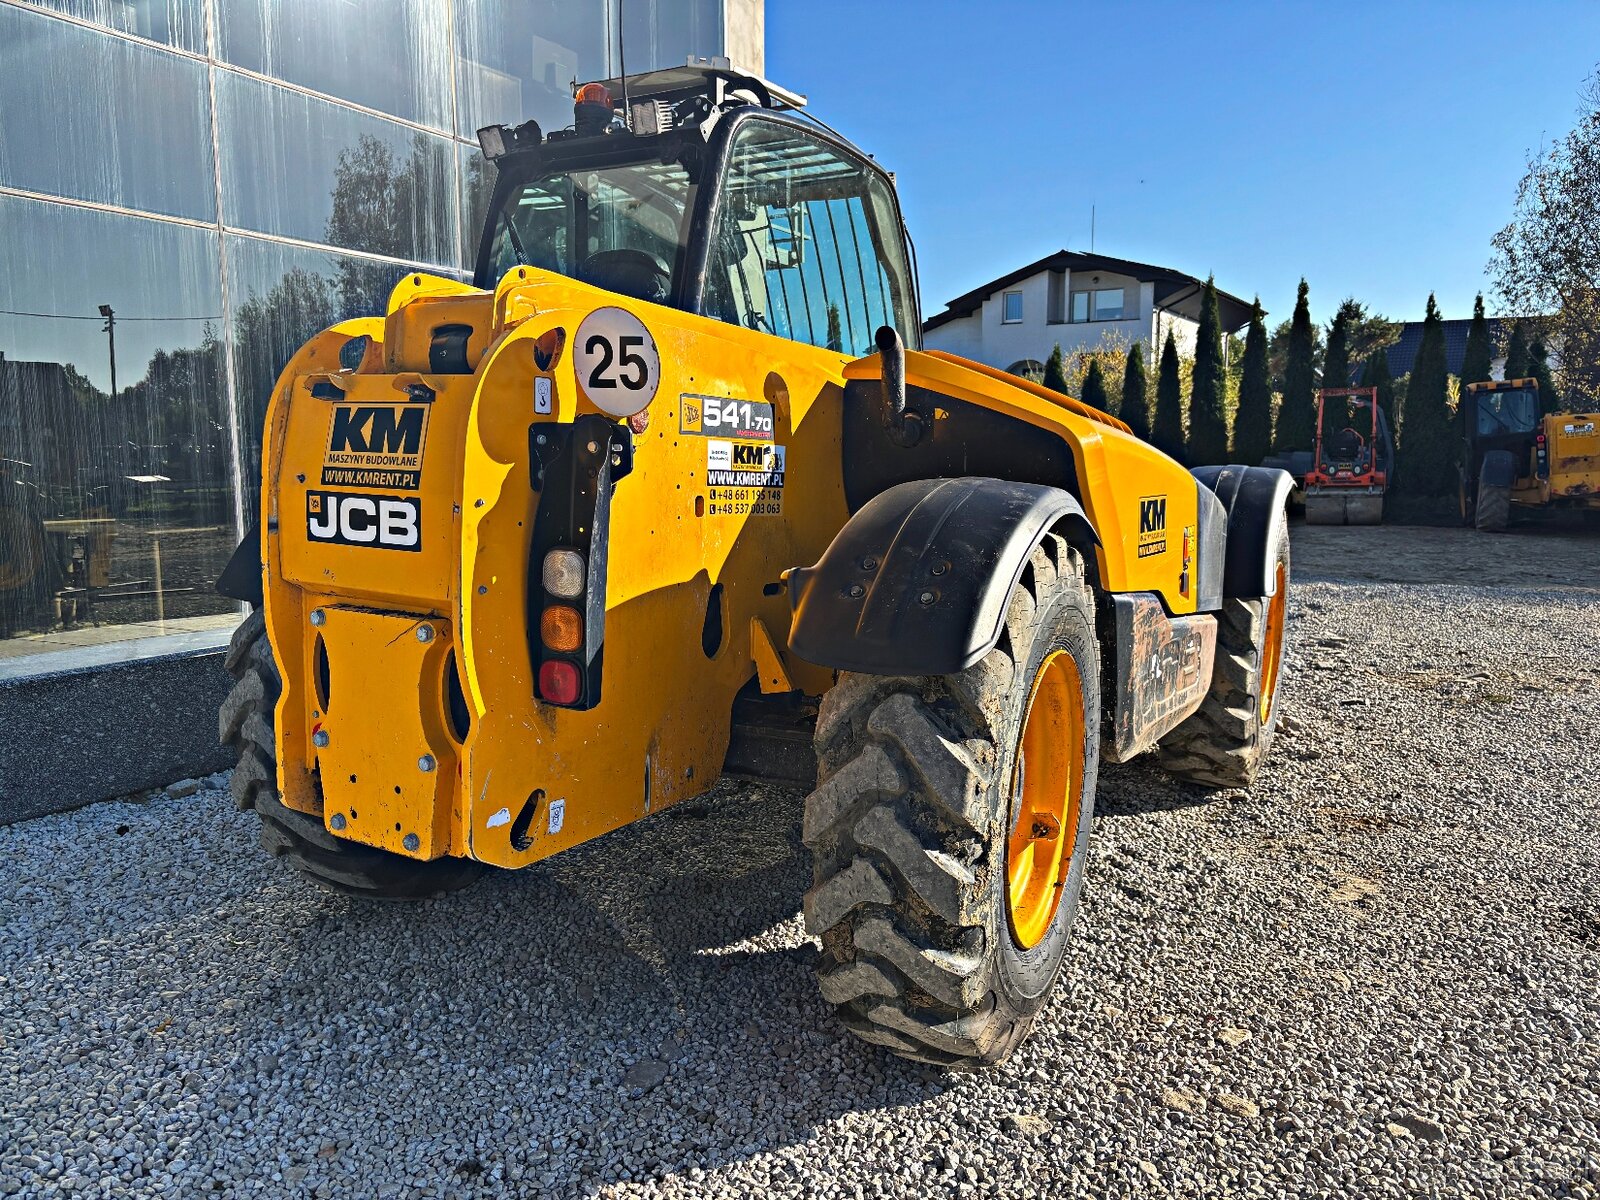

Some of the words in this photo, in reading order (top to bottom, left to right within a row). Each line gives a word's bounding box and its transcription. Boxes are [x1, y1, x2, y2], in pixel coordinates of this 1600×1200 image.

[585, 335, 649, 390] 25
[330, 407, 425, 454] KM
[328, 454, 365, 464] MASZYNY
[366, 455, 418, 466] BUDOWLANE
[733, 445, 763, 465] KM
[325, 470, 416, 487] WWW.KMRENT.PL
[708, 470, 783, 486] WWW.KMRENT.PL
[717, 490, 733, 500] +48
[735, 489, 749, 500] 661
[752, 490, 765, 500] 195
[768, 490, 781, 500] 148
[717, 504, 733, 514] +48
[734, 504, 750, 514] 537
[752, 504, 765, 514] 003
[767, 504, 781, 514] 063
[1140, 499, 1166, 534] KM
[309, 496, 419, 546] JCB
